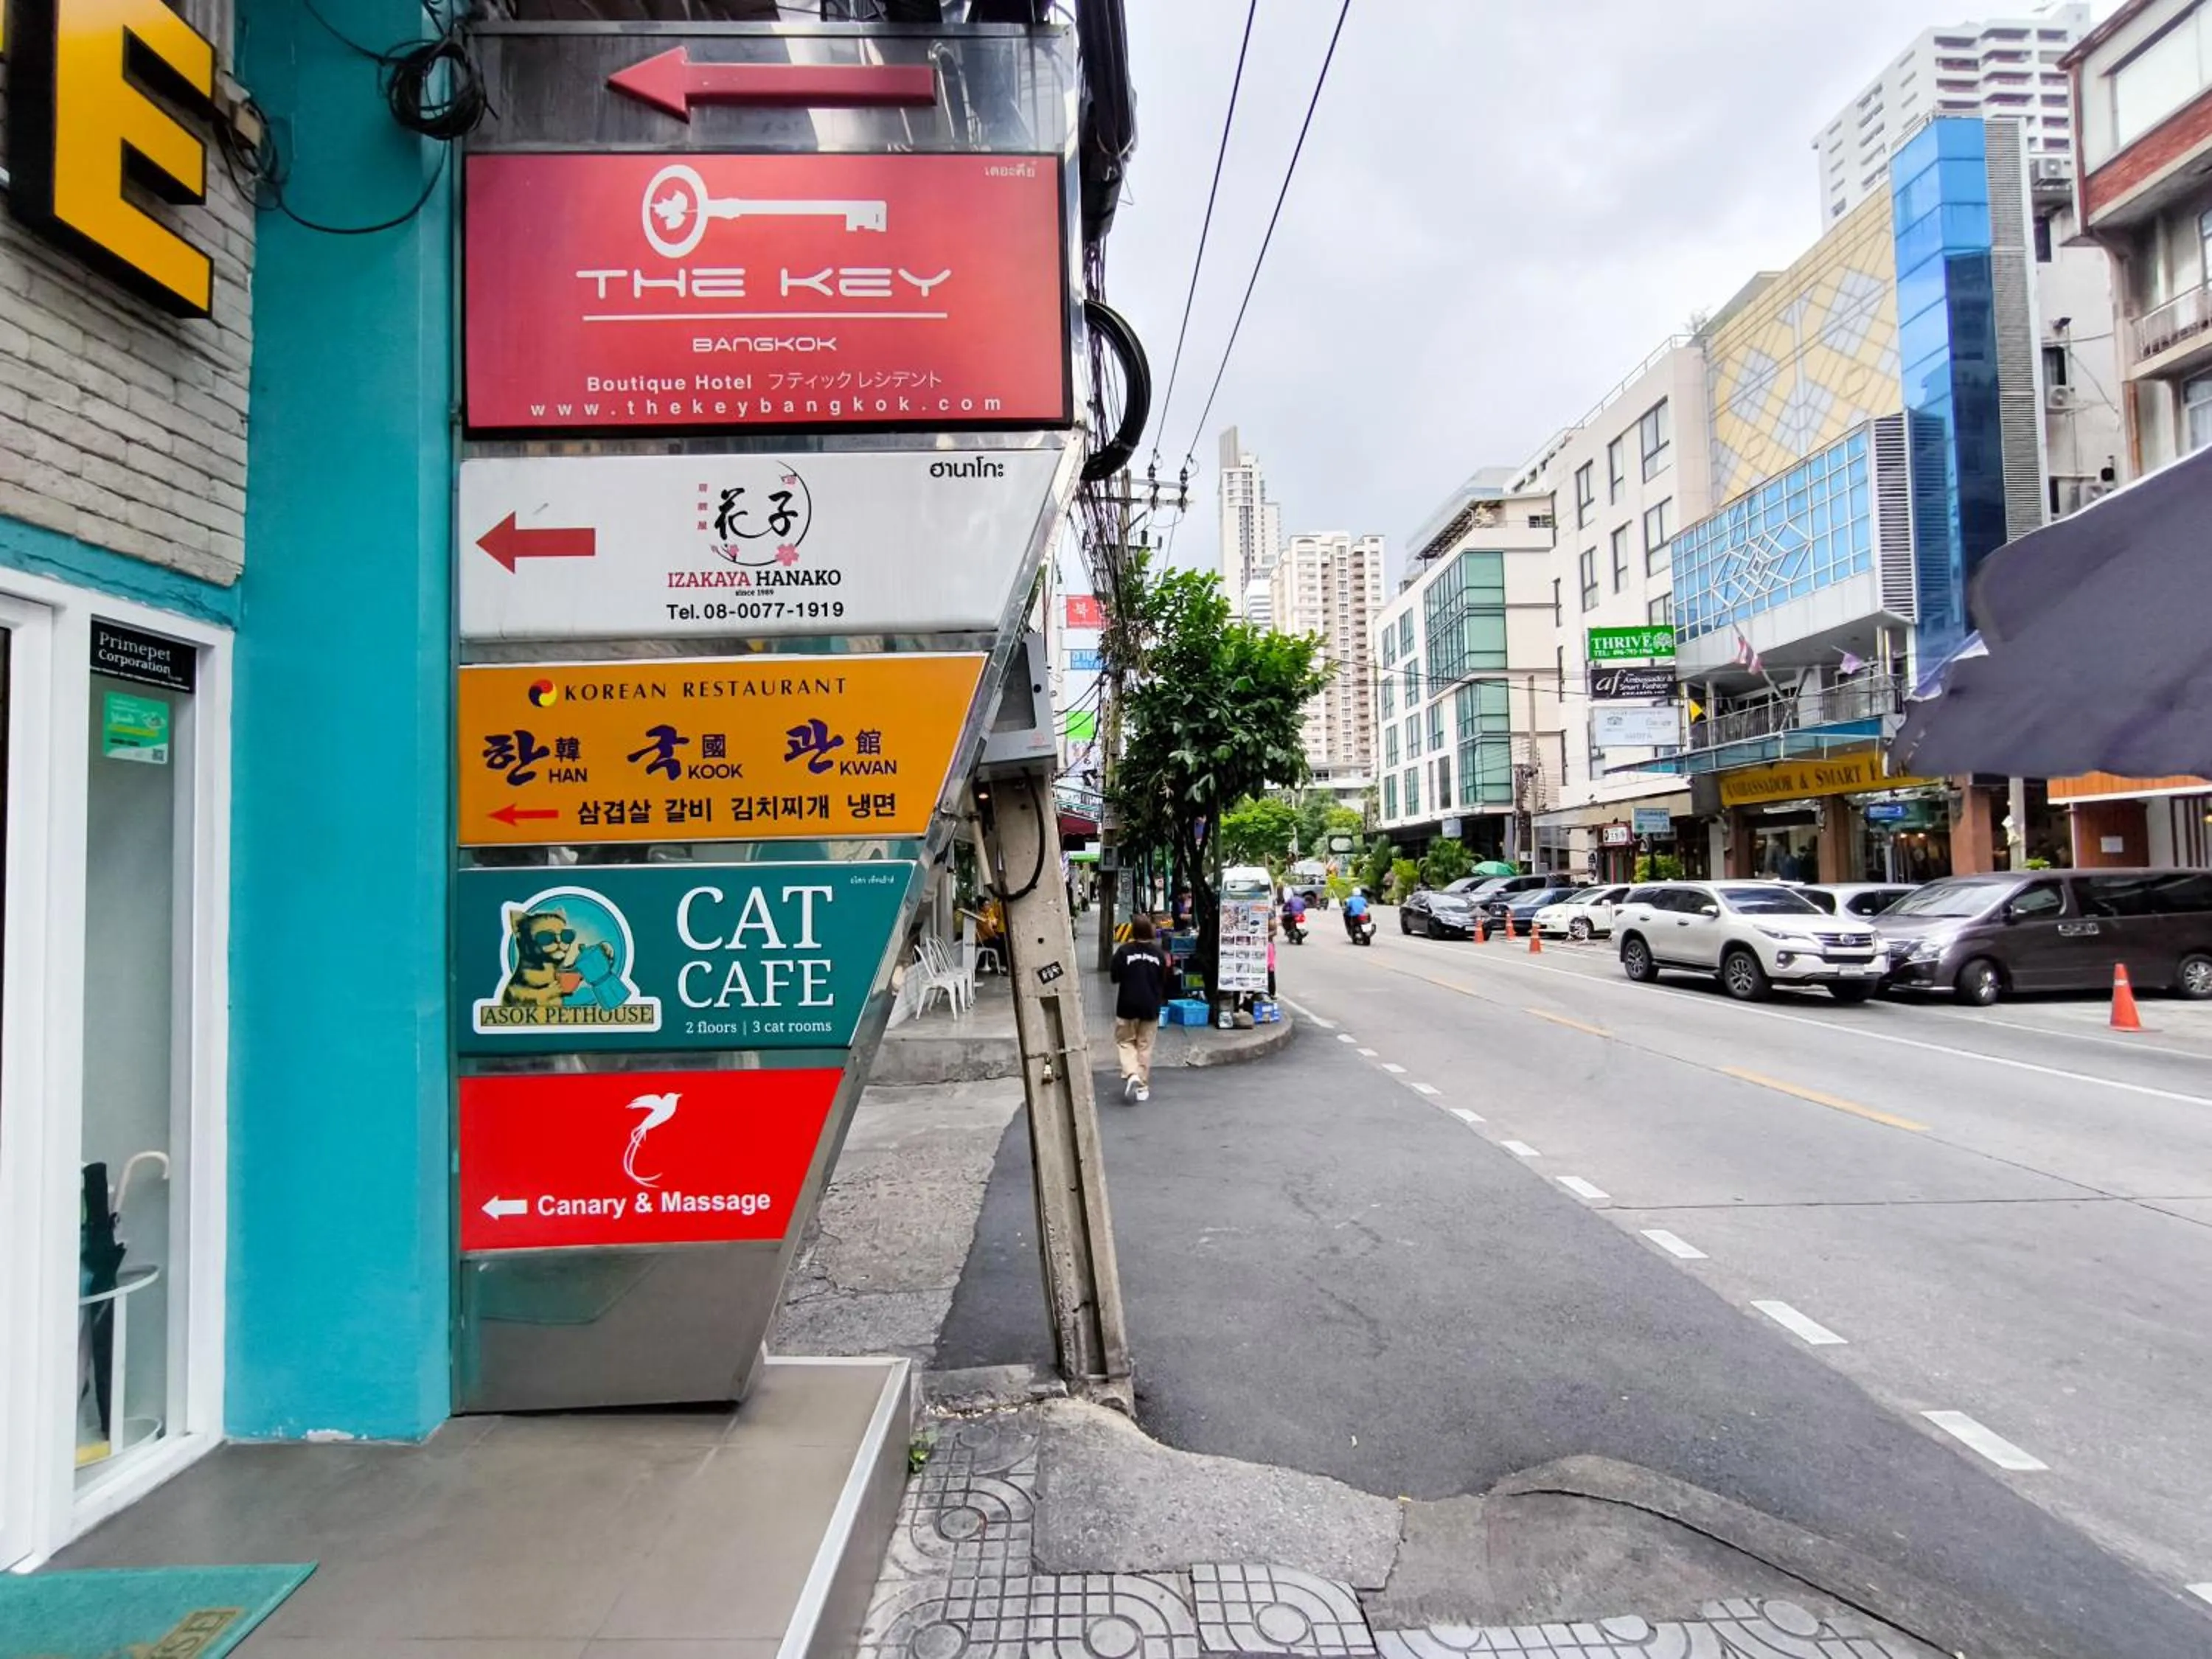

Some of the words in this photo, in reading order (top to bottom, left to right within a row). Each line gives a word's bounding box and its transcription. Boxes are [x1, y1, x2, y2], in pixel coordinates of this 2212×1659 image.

[0, 0, 215, 313] E
[576, 268, 745, 299] THE
[780, 267, 952, 297] KEY
[692, 337, 838, 352] BANGKOK
[587, 376, 686, 394] Boutique
[695, 373, 752, 390] Hotel
[530, 396, 1002, 418] www.thekeybangkok.com
[930, 456, 1004, 478] ฮานาโกะ
[668, 571, 751, 588] IZAKAYA
[756, 569, 841, 586] HANAKO
[100, 631, 171, 661] Primepet
[1591, 635, 1652, 650] THRIVE
[98, 649, 171, 674] Corporation
[565, 683, 667, 700] KOREAN
[684, 678, 846, 698] RESTAURANT
[554, 737, 581, 762] 韓
[549, 767, 588, 783] HAN
[688, 763, 744, 779] KOOK
[840, 759, 897, 776] KWAN
[577, 799, 652, 825] 삼겹살
[665, 797, 712, 824] 갈비
[731, 794, 830, 821] 김치찌개
[847, 793, 896, 818] 냉면
[676, 886, 834, 951] CAT
[677, 959, 835, 1008] CAFE
[484, 1007, 538, 1025] ASOK
[545, 1006, 653, 1024] PETHOUSE
[686, 1021, 694, 1033] 2
[698, 1020, 737, 1033] floors
[753, 1021, 761, 1033] 3
[764, 1021, 785, 1033] cat
[790, 1021, 832, 1033] rooms
[538, 1193, 626, 1218] Canary
[635, 1192, 653, 1213] &
[661, 1191, 771, 1216] Massage
